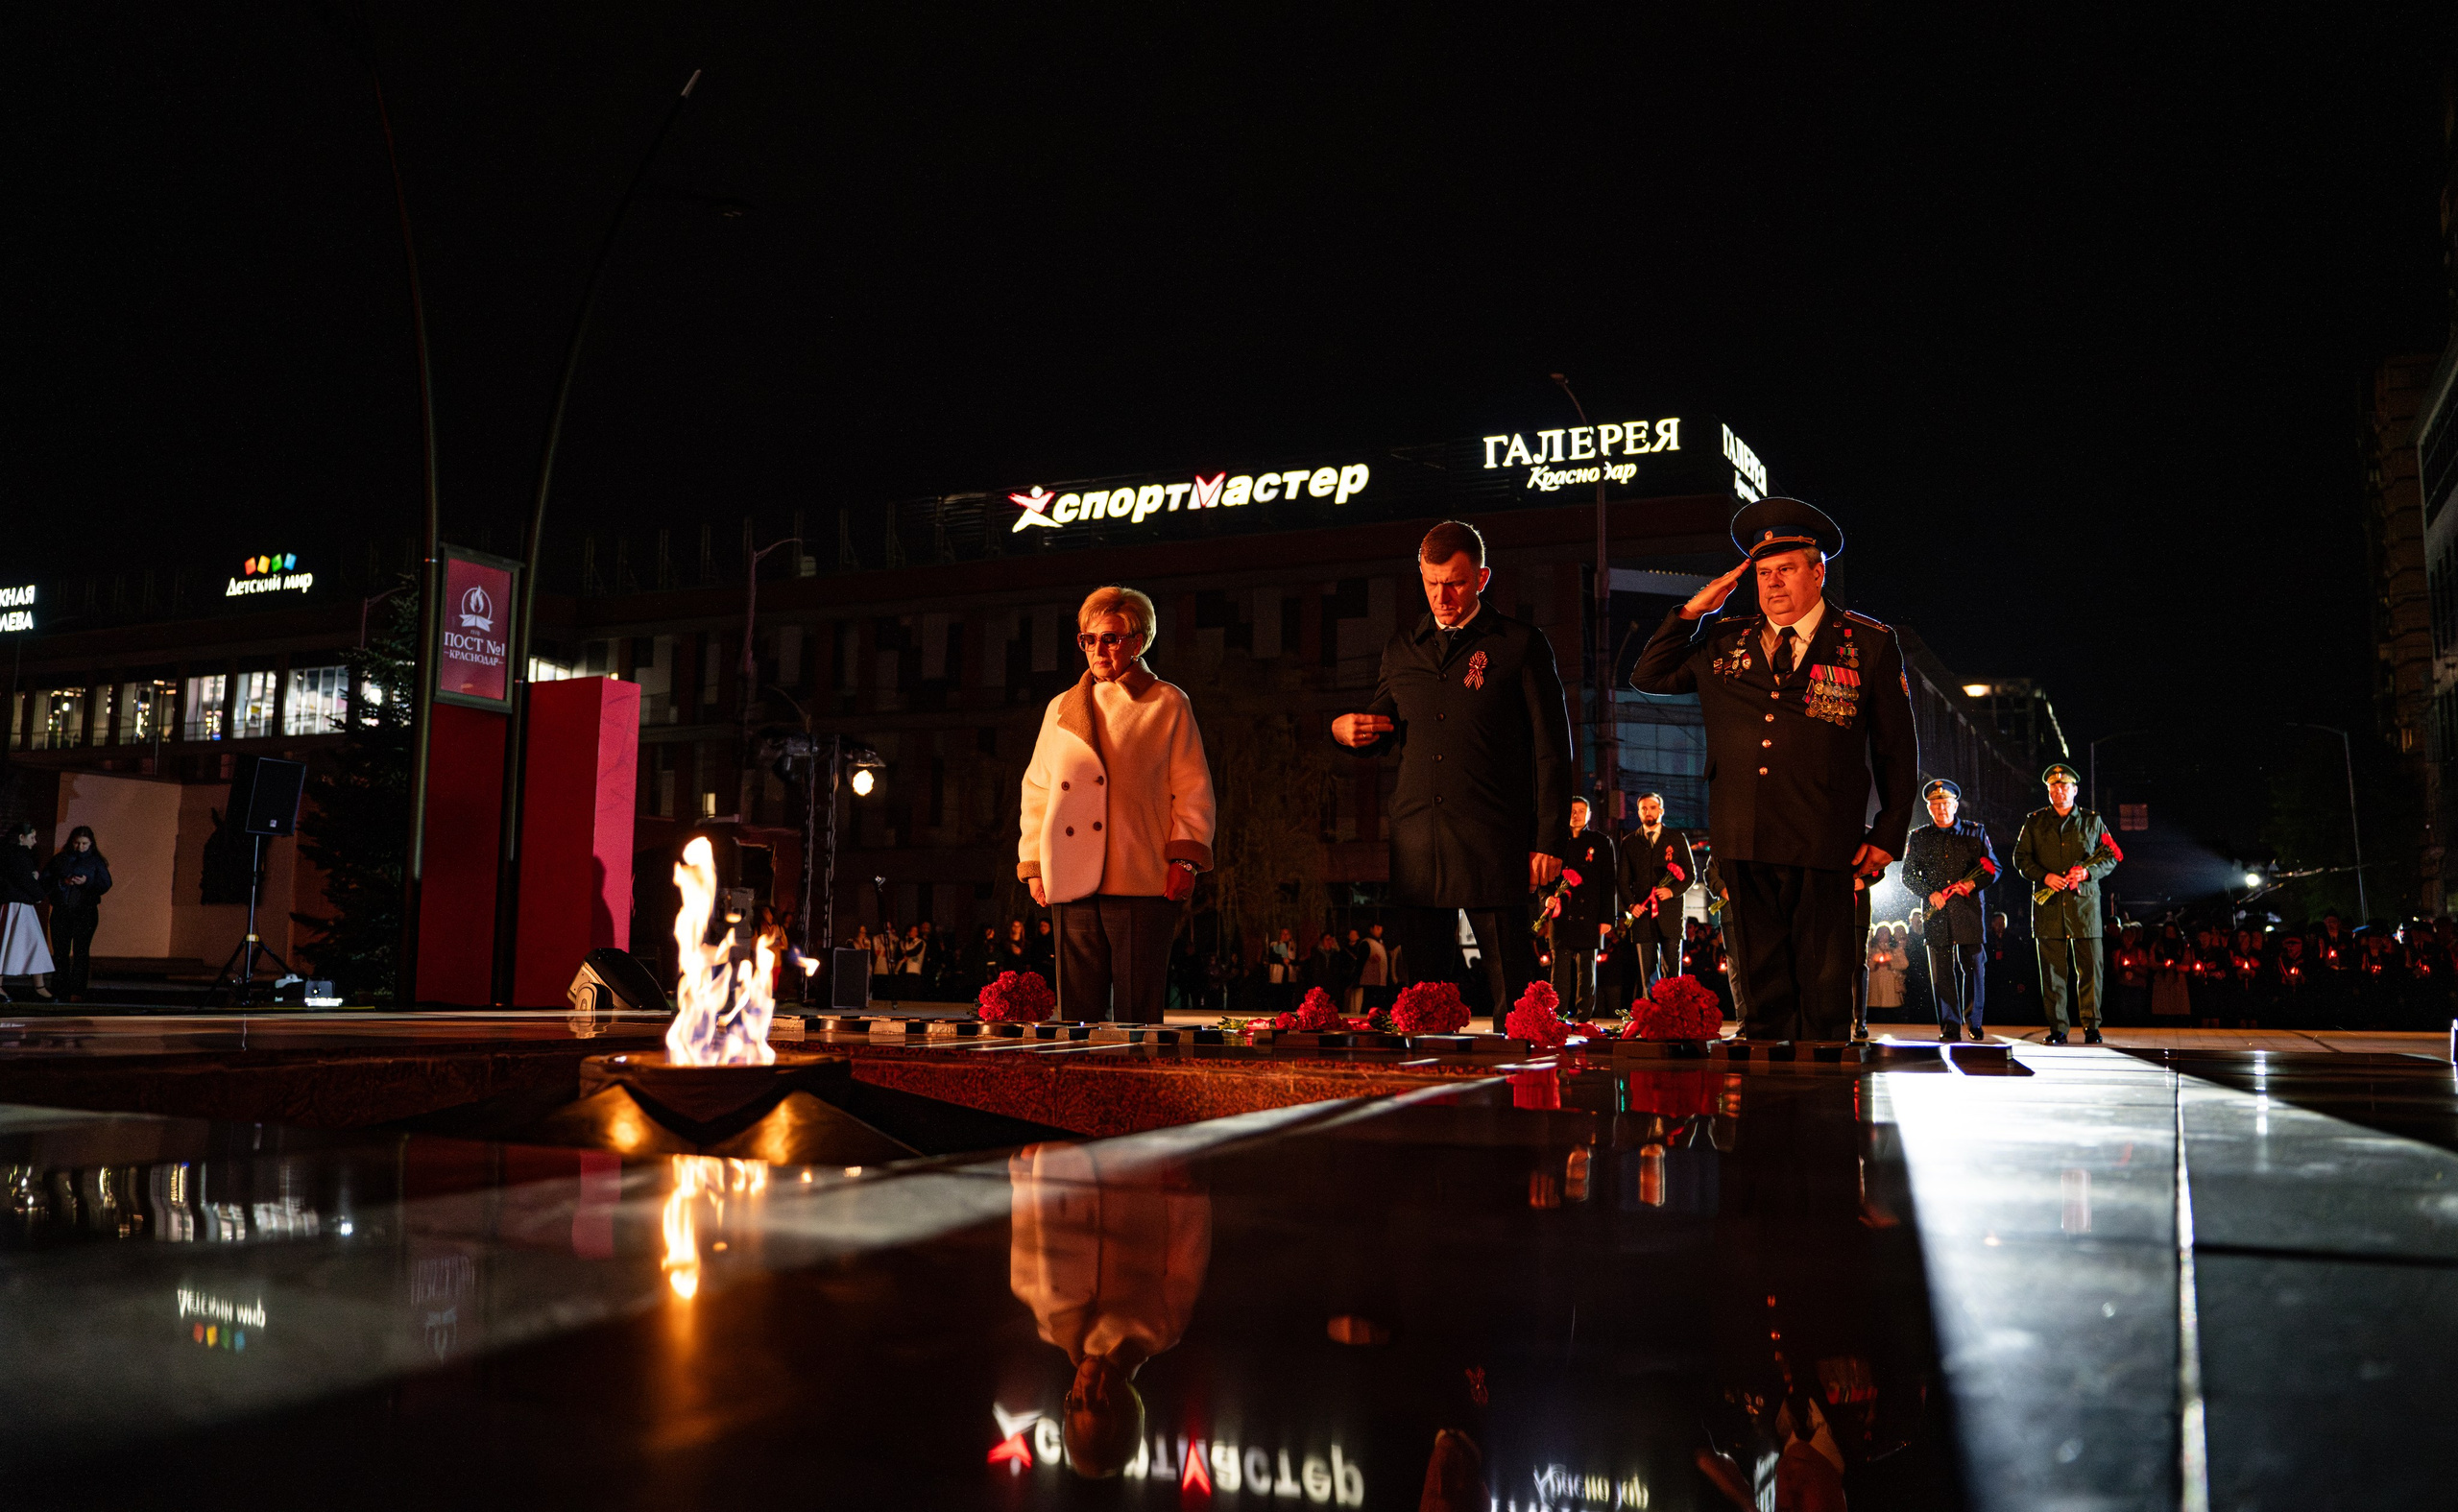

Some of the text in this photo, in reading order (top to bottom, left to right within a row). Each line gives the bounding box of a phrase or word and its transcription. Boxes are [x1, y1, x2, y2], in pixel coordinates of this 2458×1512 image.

[1482, 417, 1681, 468] ГАЛЕРЕЯ
[226, 572, 313, 596] Детский мир
[445, 633, 505, 657] ПОСТ №1
